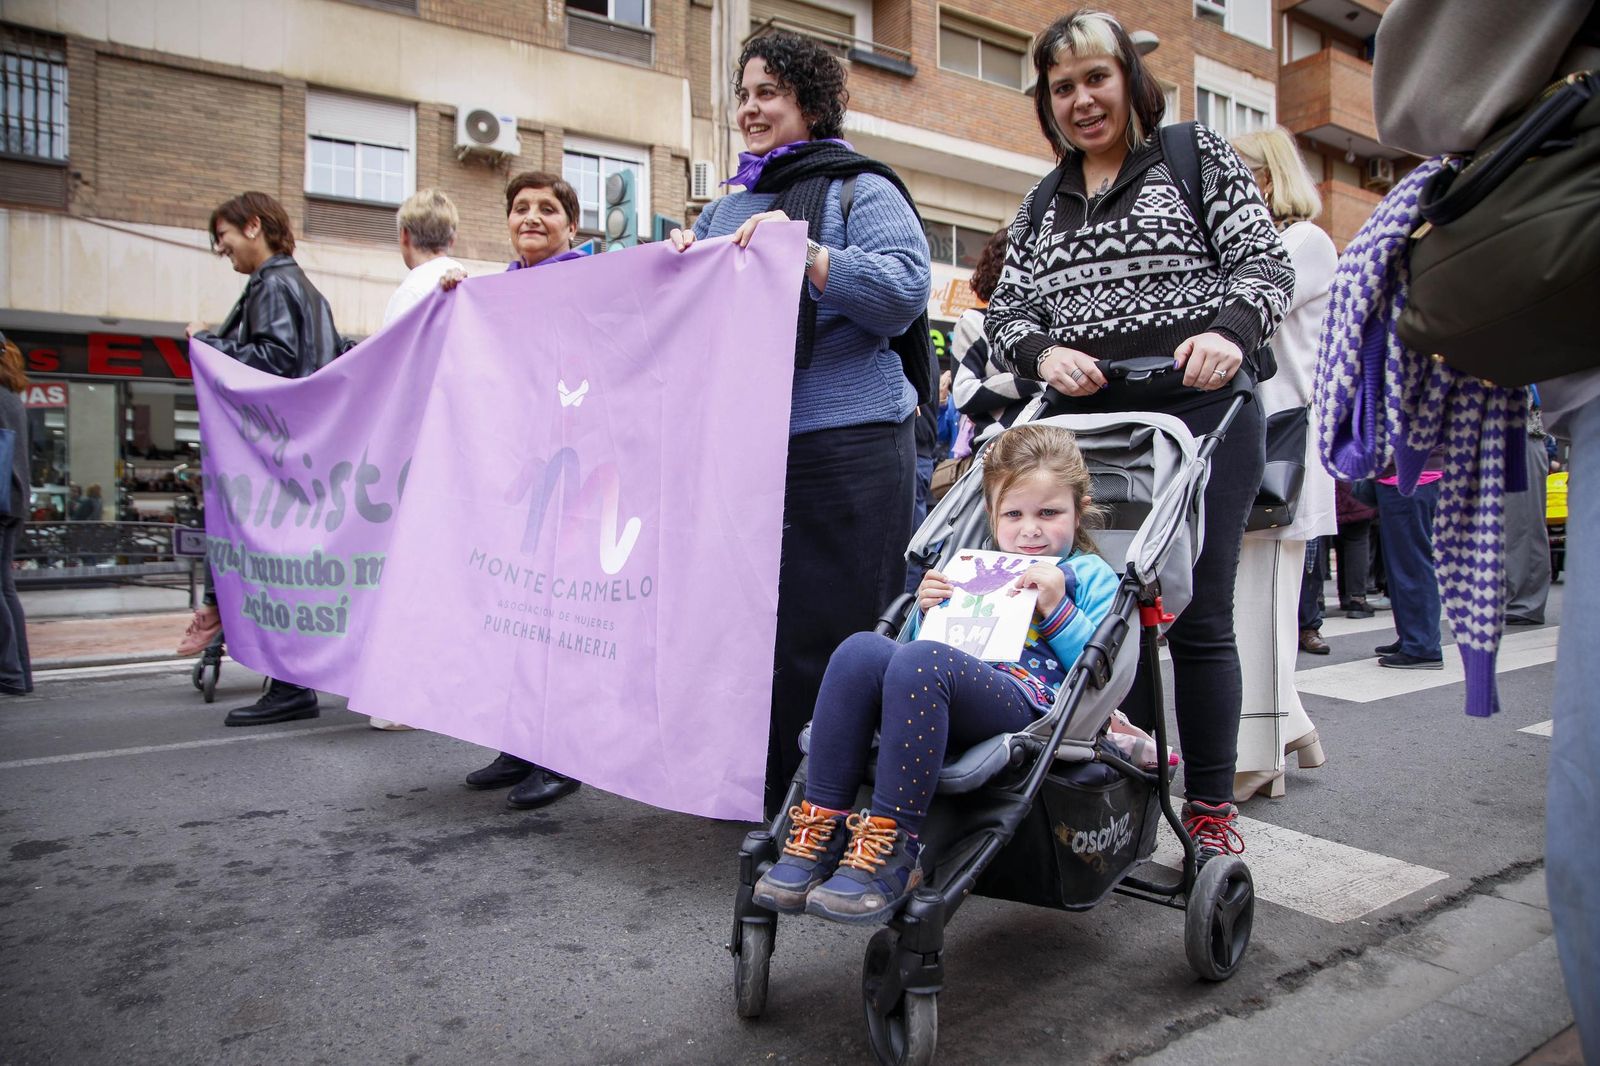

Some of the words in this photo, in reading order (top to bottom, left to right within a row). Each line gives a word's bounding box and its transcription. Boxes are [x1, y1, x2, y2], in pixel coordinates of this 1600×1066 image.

[1137, 217, 1198, 234] CLU
[1048, 266, 1113, 288] CLUB
[249, 550, 346, 587] mundo
[468, 547, 547, 594] MONTE
[551, 575, 653, 602] CARMELO
[296, 595, 348, 634] así
[574, 615, 616, 632] MUJERES
[483, 614, 551, 645] PURCHENA
[558, 631, 617, 661] ALMERIA
[1071, 812, 1130, 854] asalvo
